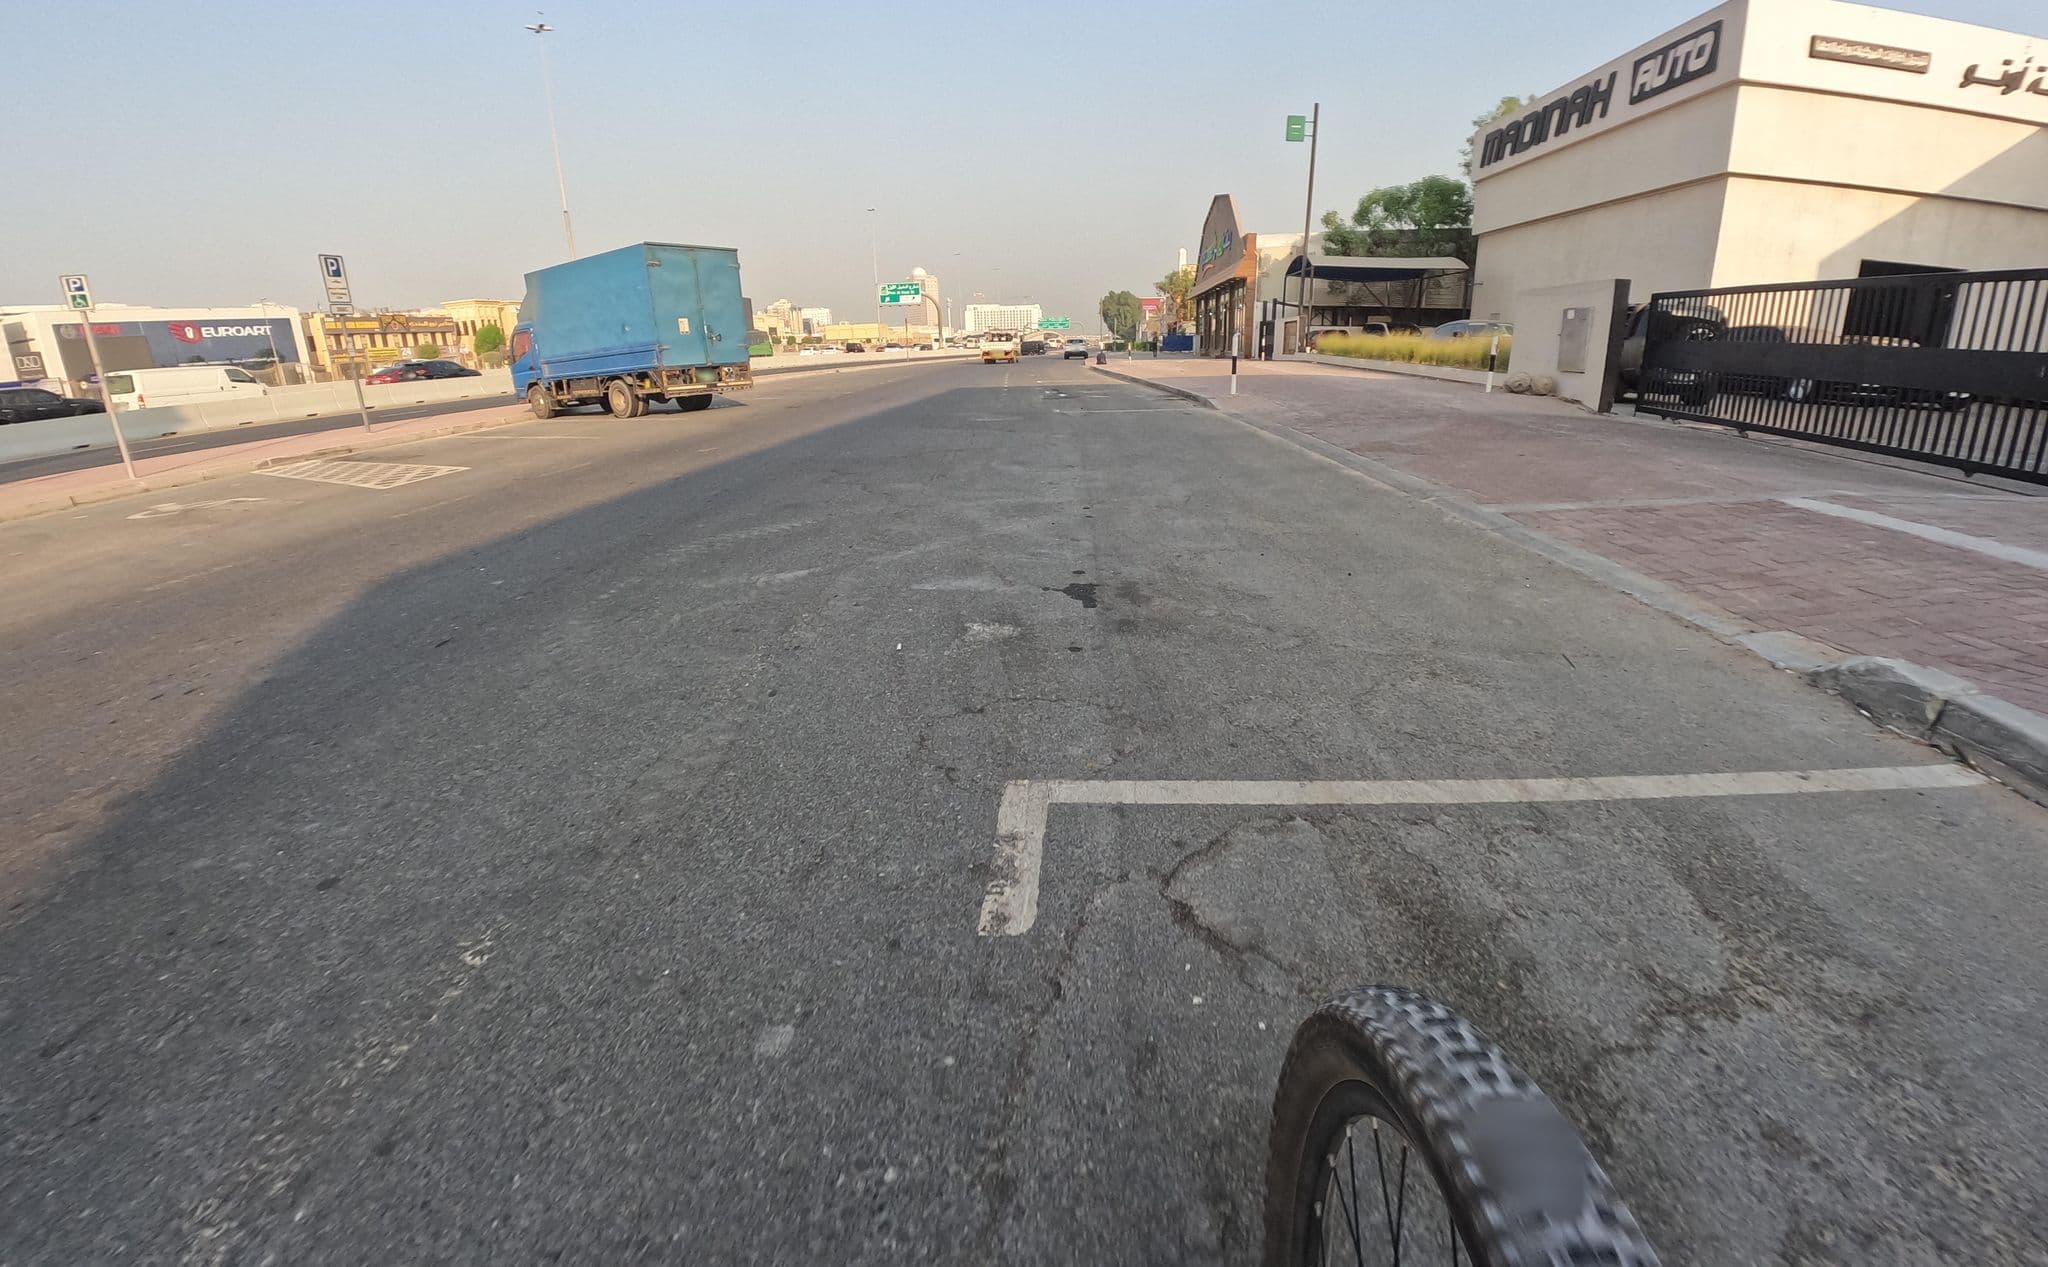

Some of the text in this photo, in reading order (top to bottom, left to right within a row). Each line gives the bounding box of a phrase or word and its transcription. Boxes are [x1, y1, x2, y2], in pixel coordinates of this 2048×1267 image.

[1479, 30, 1715, 168] MADINAH AUTO
[327, 259, 338, 276] P
[69, 278, 81, 292] P
[201, 326, 272, 338] EUROART
